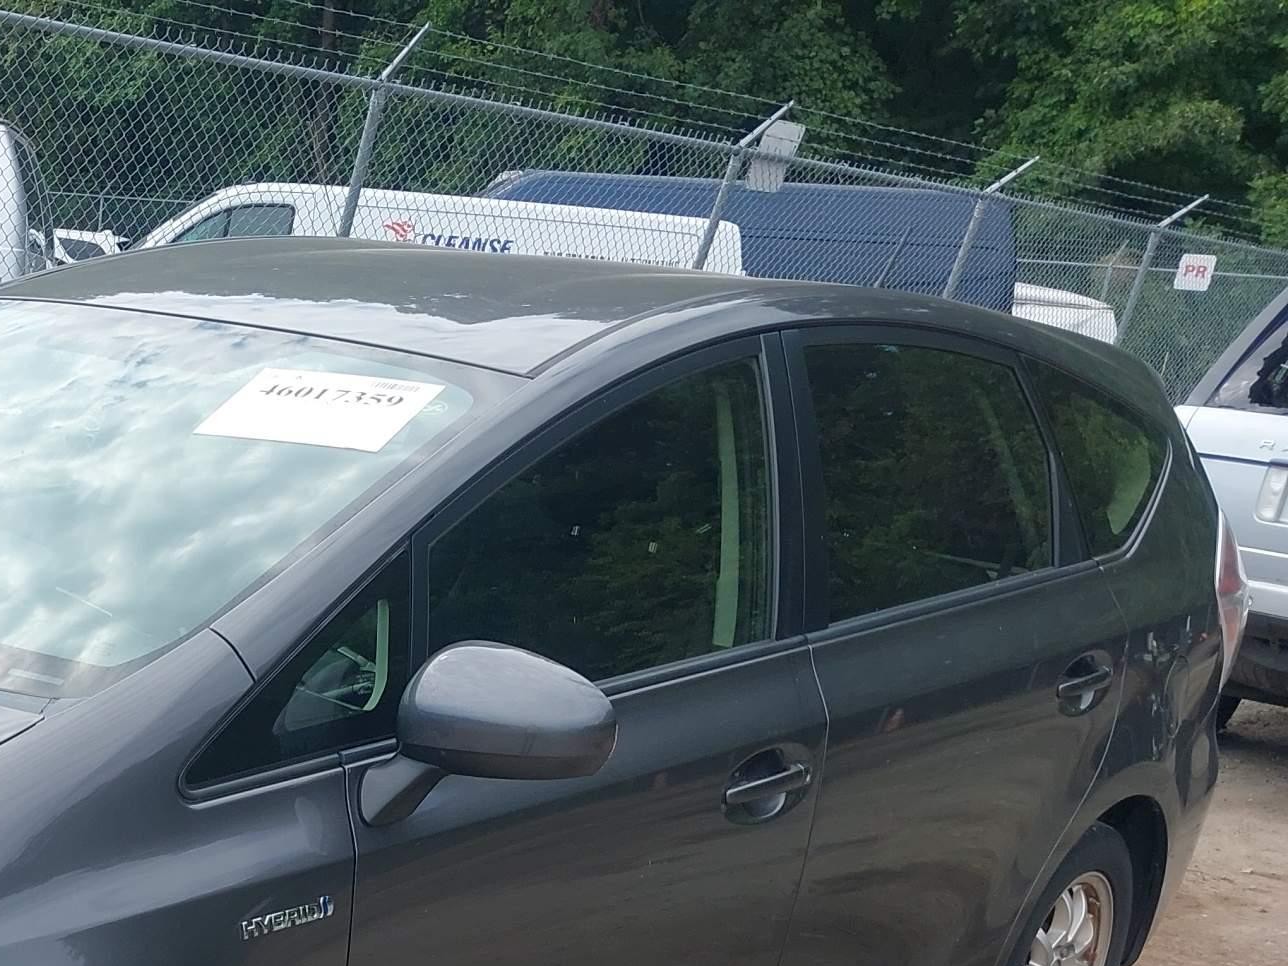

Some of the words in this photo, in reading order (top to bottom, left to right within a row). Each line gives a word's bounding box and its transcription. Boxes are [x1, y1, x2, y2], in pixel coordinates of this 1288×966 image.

[1184, 265, 1208, 278] PR
[260, 384, 404, 407] 46017359
[241, 903, 319, 940] HYBRID
